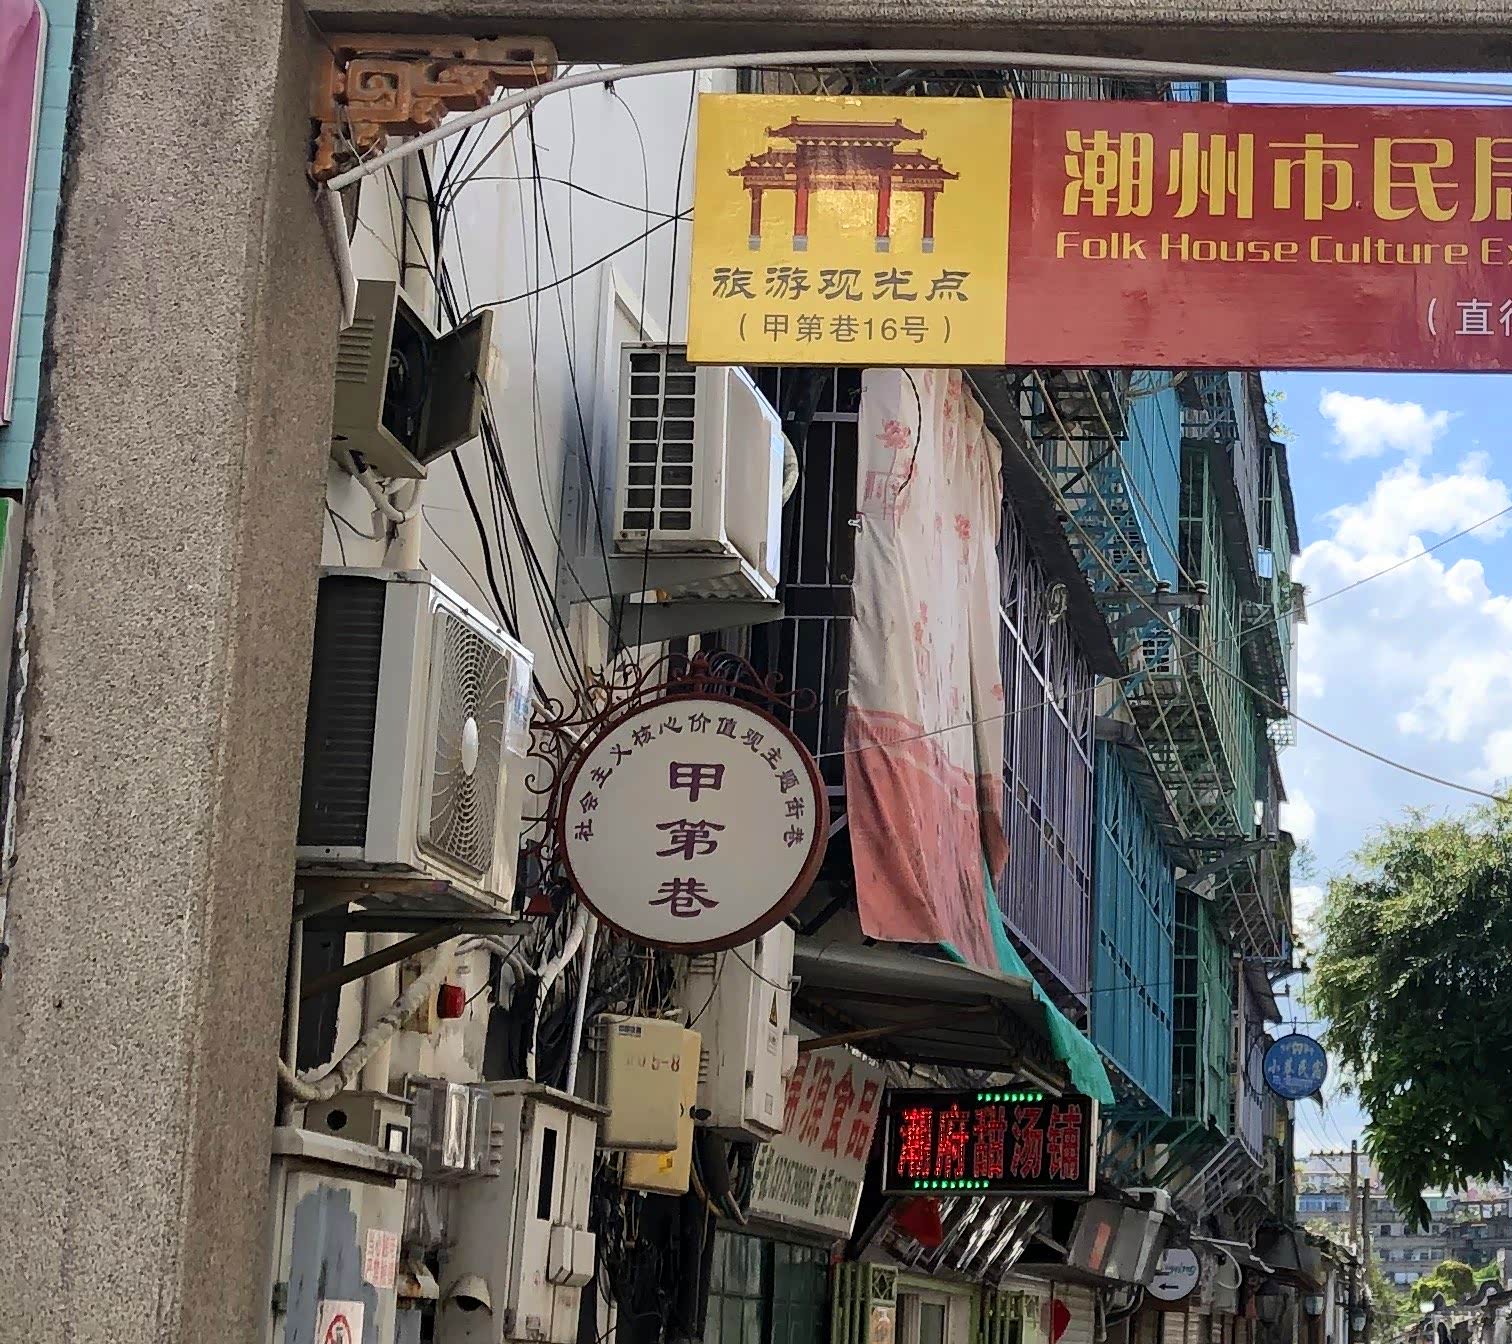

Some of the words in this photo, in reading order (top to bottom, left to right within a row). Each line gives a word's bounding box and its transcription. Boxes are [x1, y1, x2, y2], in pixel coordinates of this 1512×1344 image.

[709, 264, 972, 304] 旅游观光点
[1056, 231, 1147, 260] Folk
[1161, 232, 1298, 264] House
[1310, 236, 1468, 265] Culture
[573, 712, 806, 849] 社会主义核心价值观主题街巷
[648, 760, 727, 919] 甲第巷
[897, 1103, 1083, 1181] 潮府甜汤铺
